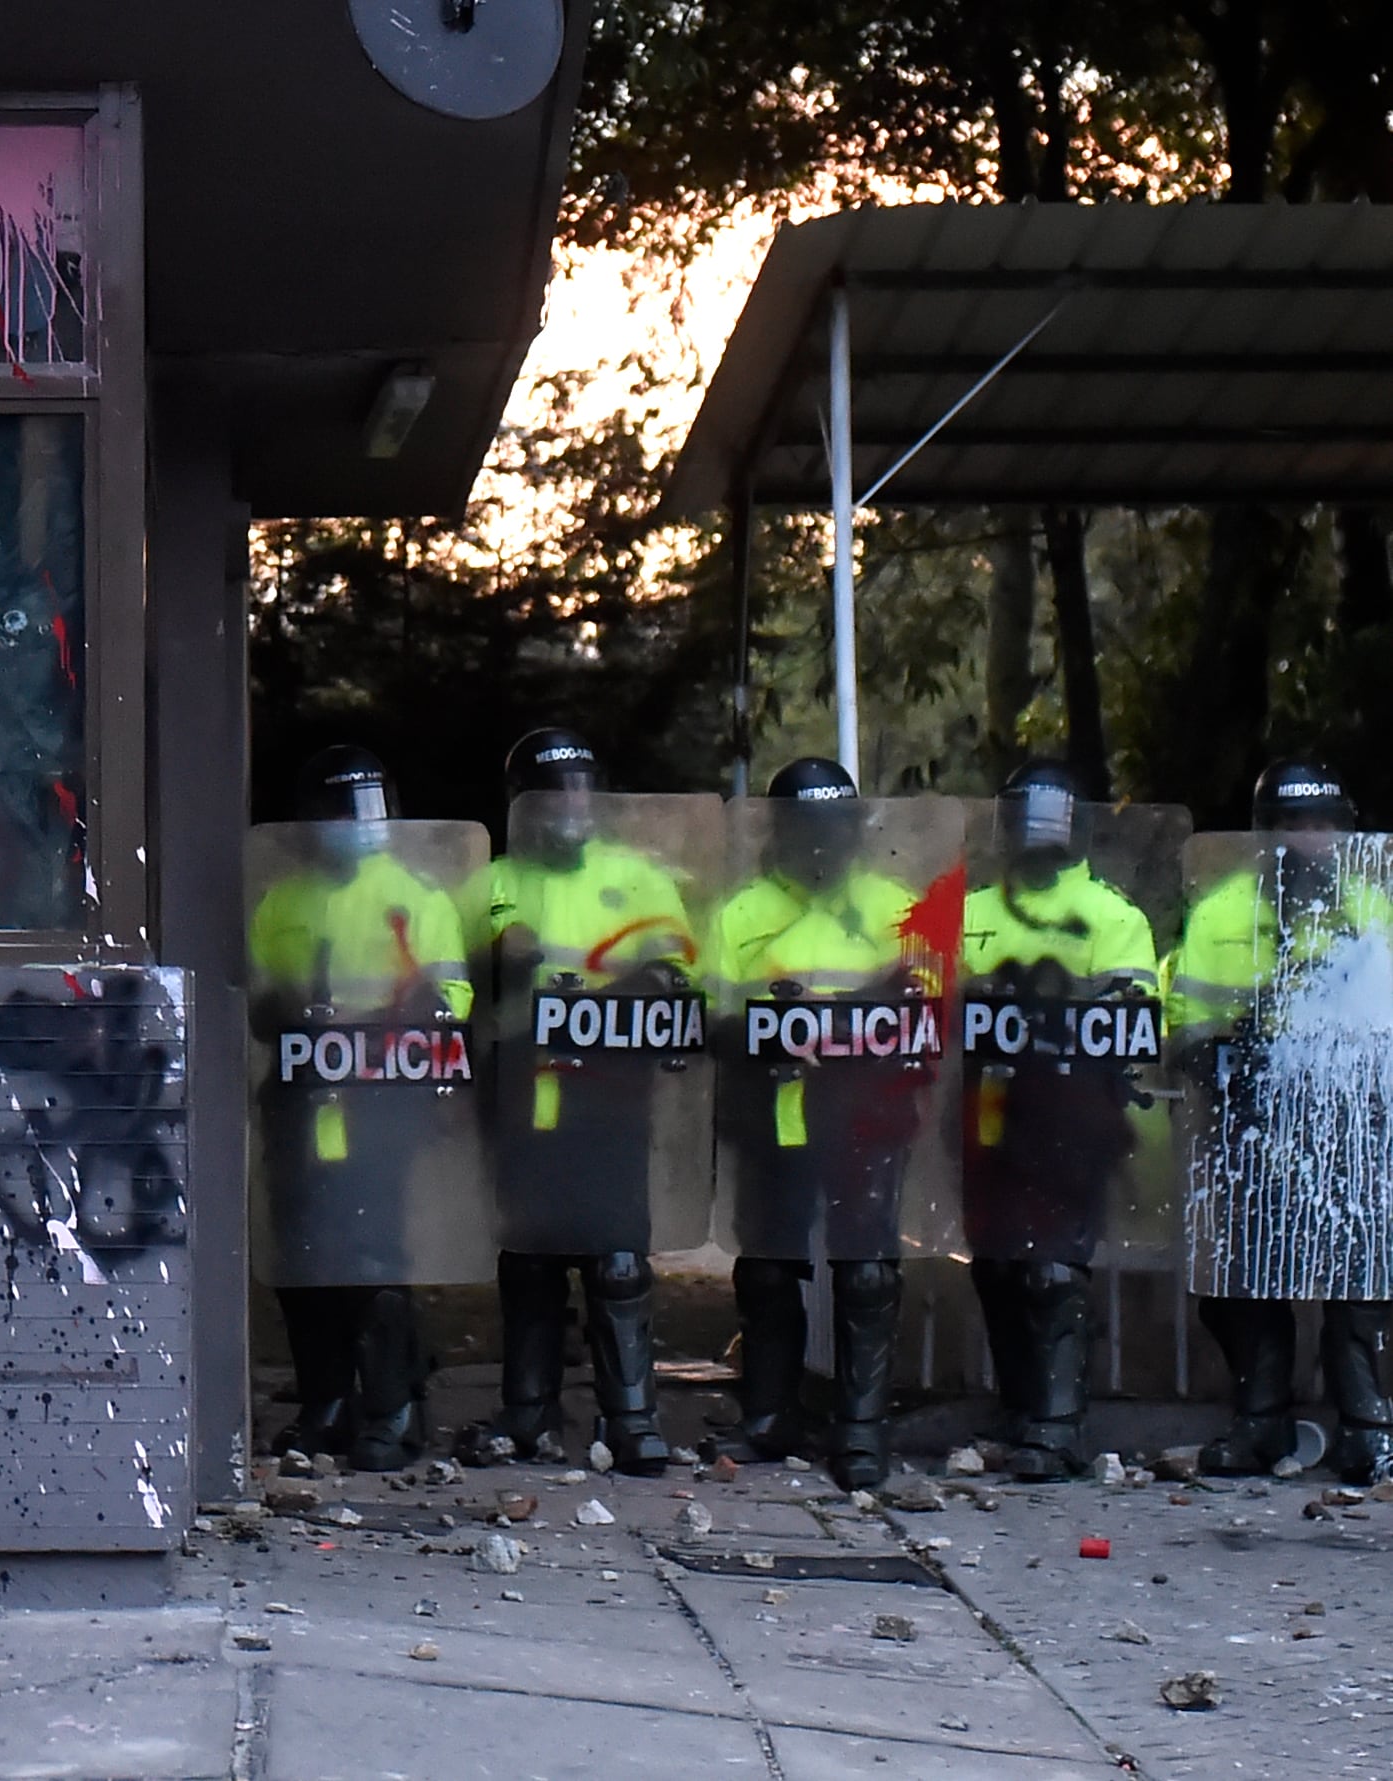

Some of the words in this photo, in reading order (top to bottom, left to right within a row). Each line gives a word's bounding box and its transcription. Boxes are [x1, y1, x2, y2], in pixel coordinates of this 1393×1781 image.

[535, 997, 705, 1049] POLICIA
[748, 1005, 942, 1057] POLICIA
[280, 1030, 473, 1083] POLICIA
